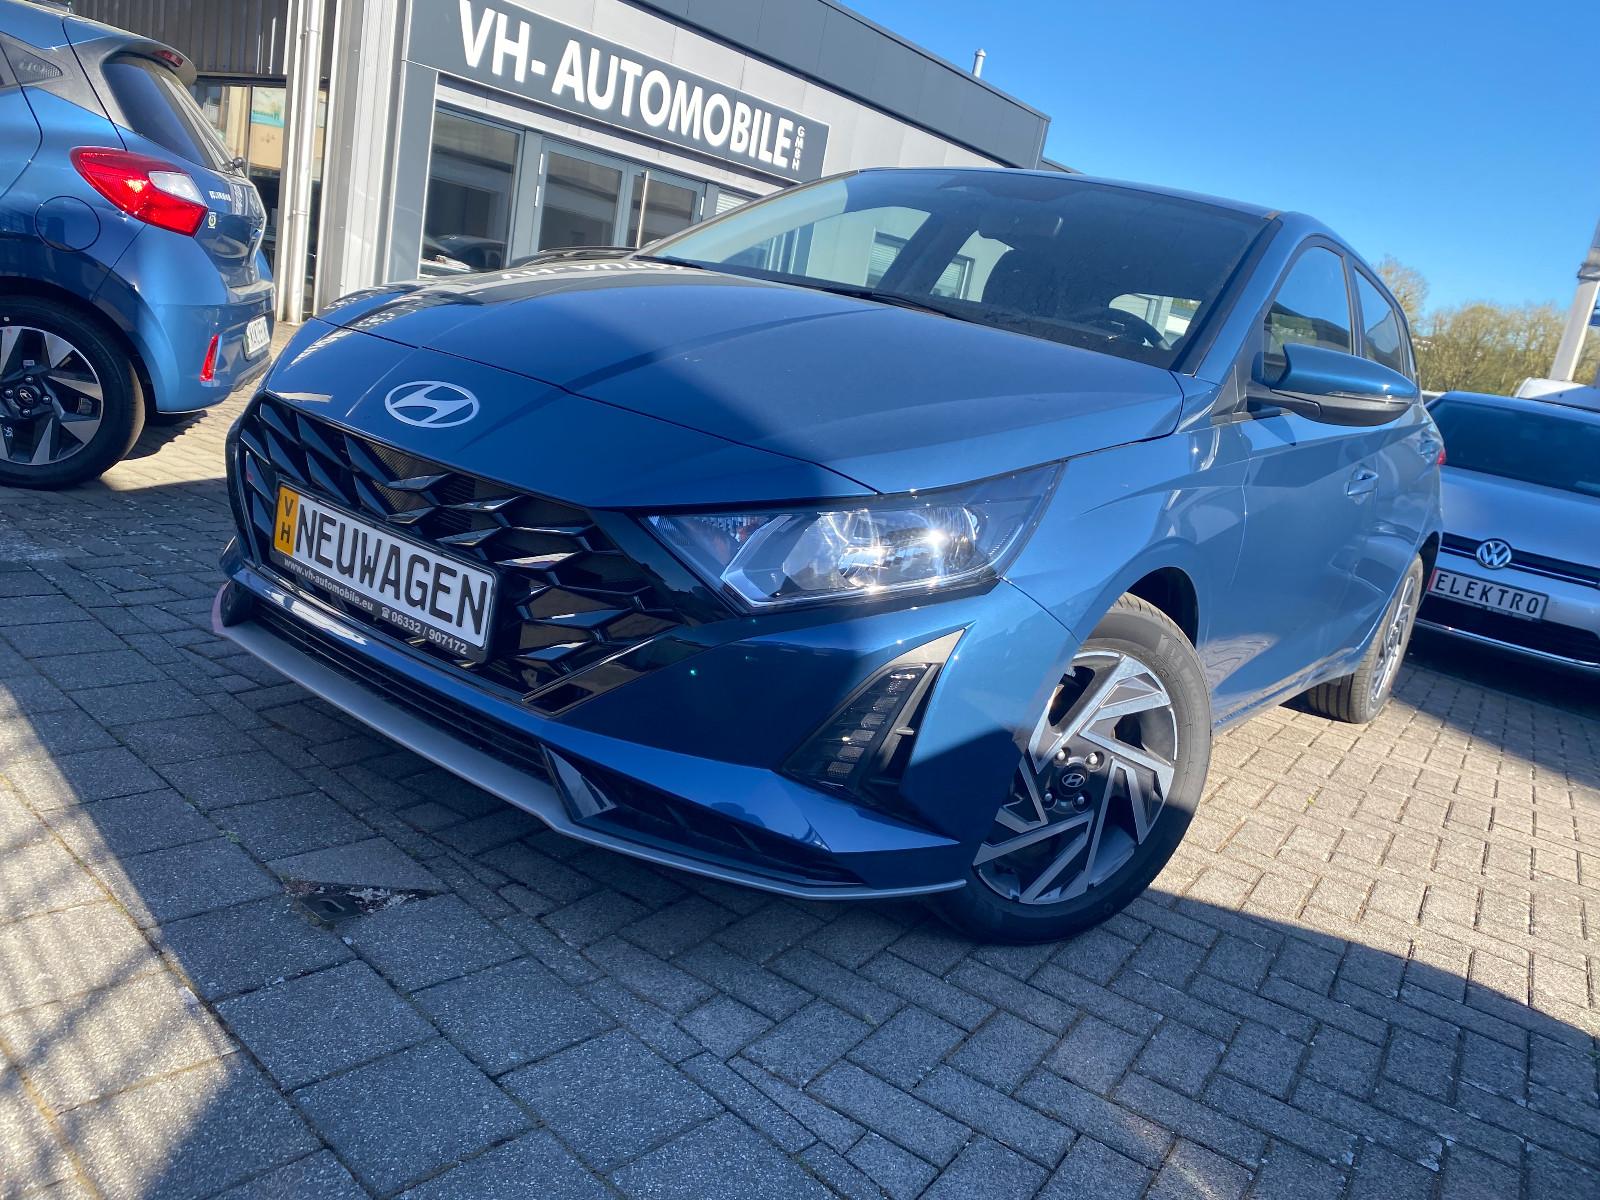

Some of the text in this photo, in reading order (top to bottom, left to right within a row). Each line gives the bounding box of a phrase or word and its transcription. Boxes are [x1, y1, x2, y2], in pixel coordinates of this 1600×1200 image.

[284, 558, 374, 611] www.vh-automobile.eu
[295, 503, 487, 635] NEUWAGEN
[1435, 573, 1539, 615] ELEKTRO
[391, 611, 421, 634] 06332
[428, 629, 468, 655] 907172
